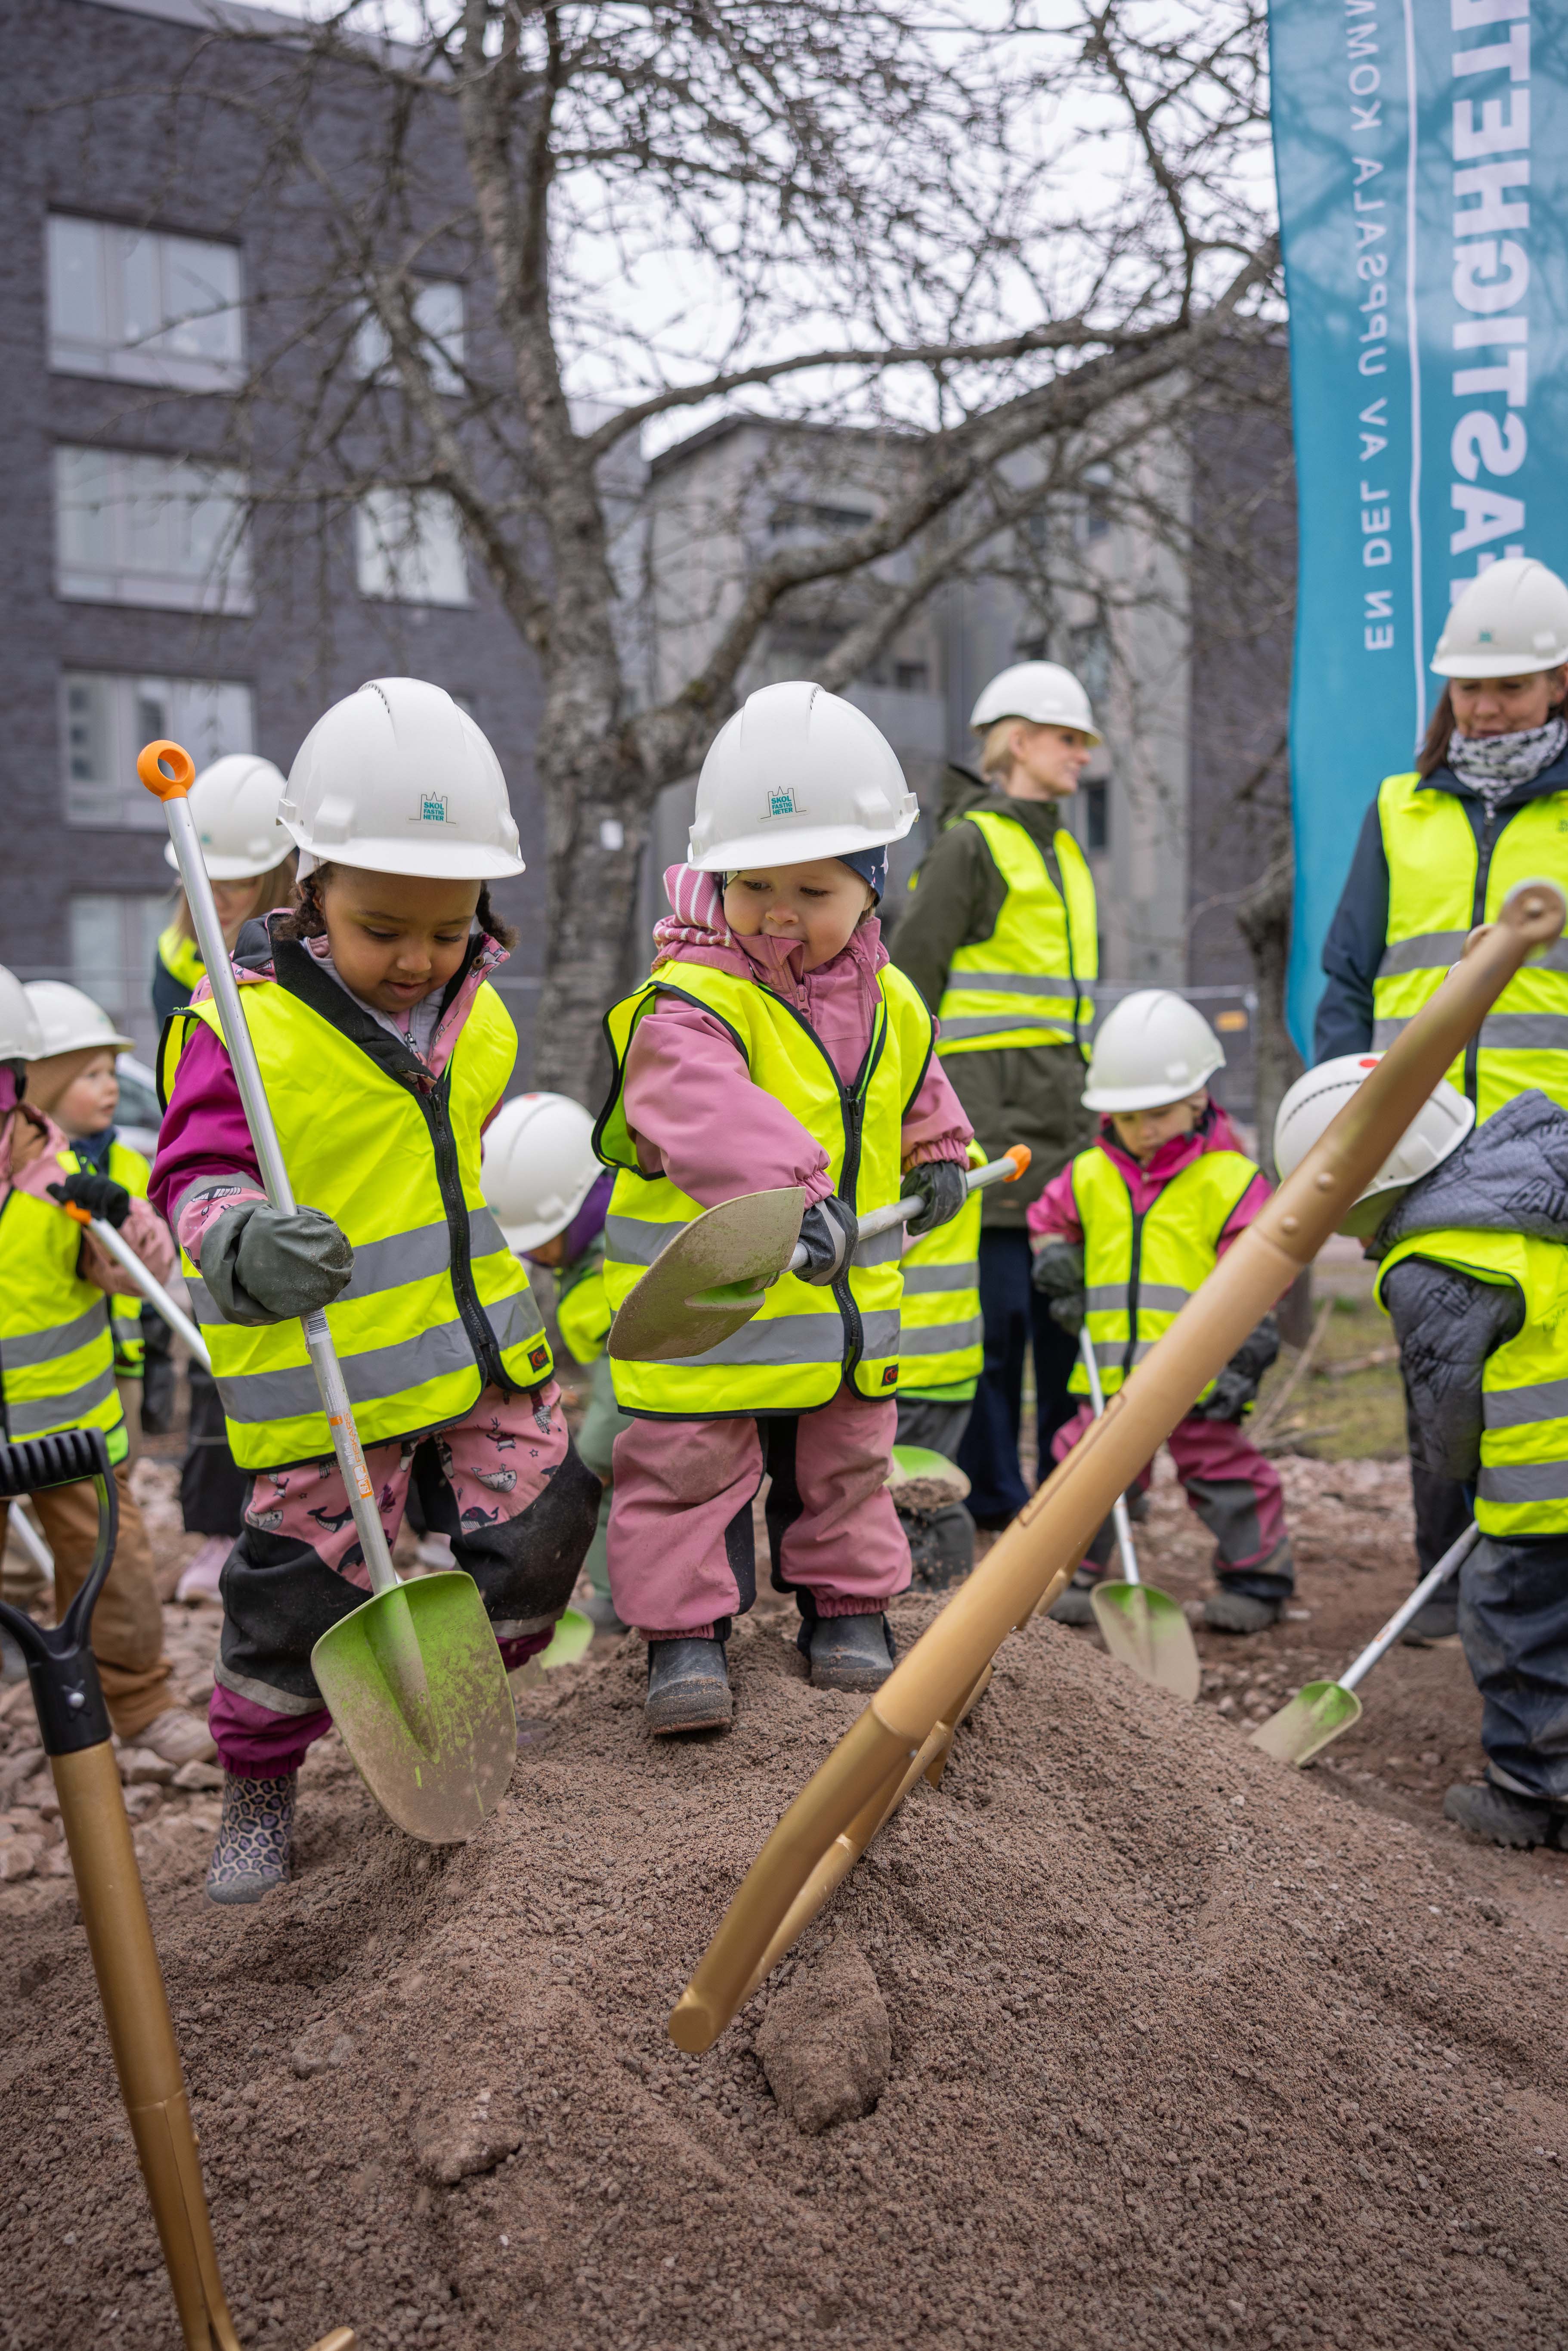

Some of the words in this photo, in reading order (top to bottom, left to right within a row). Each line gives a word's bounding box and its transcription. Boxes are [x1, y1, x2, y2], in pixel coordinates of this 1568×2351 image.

[771, 796, 792, 804] SKOL
[424, 802, 444, 810] SKOL
[344, 1413, 362, 1462] FISKARS
